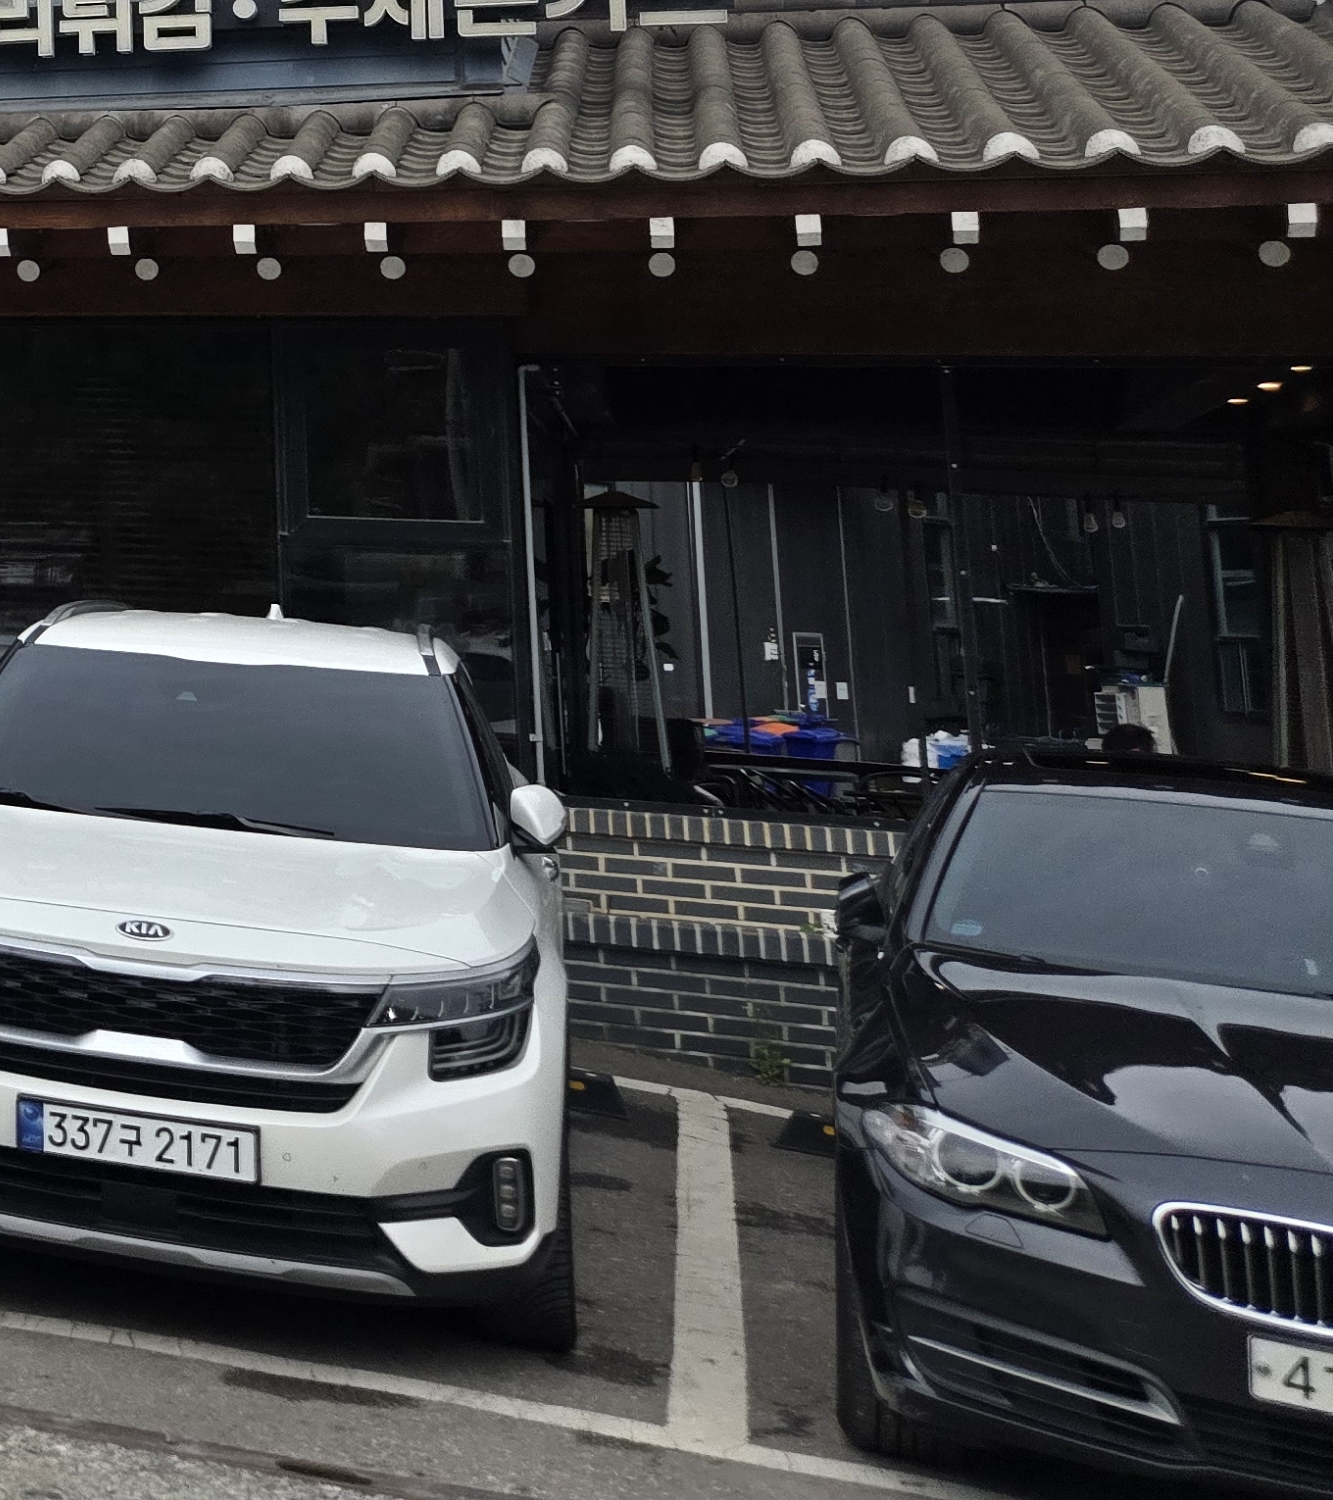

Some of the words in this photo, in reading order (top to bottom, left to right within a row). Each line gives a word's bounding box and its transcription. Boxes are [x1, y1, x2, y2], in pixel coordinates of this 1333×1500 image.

[125, 921, 164, 936] KIA
[47, 1111, 142, 1157] 337구
[154, 1126, 240, 1173] 2171
[1282, 1355, 1333, 1400] 4
